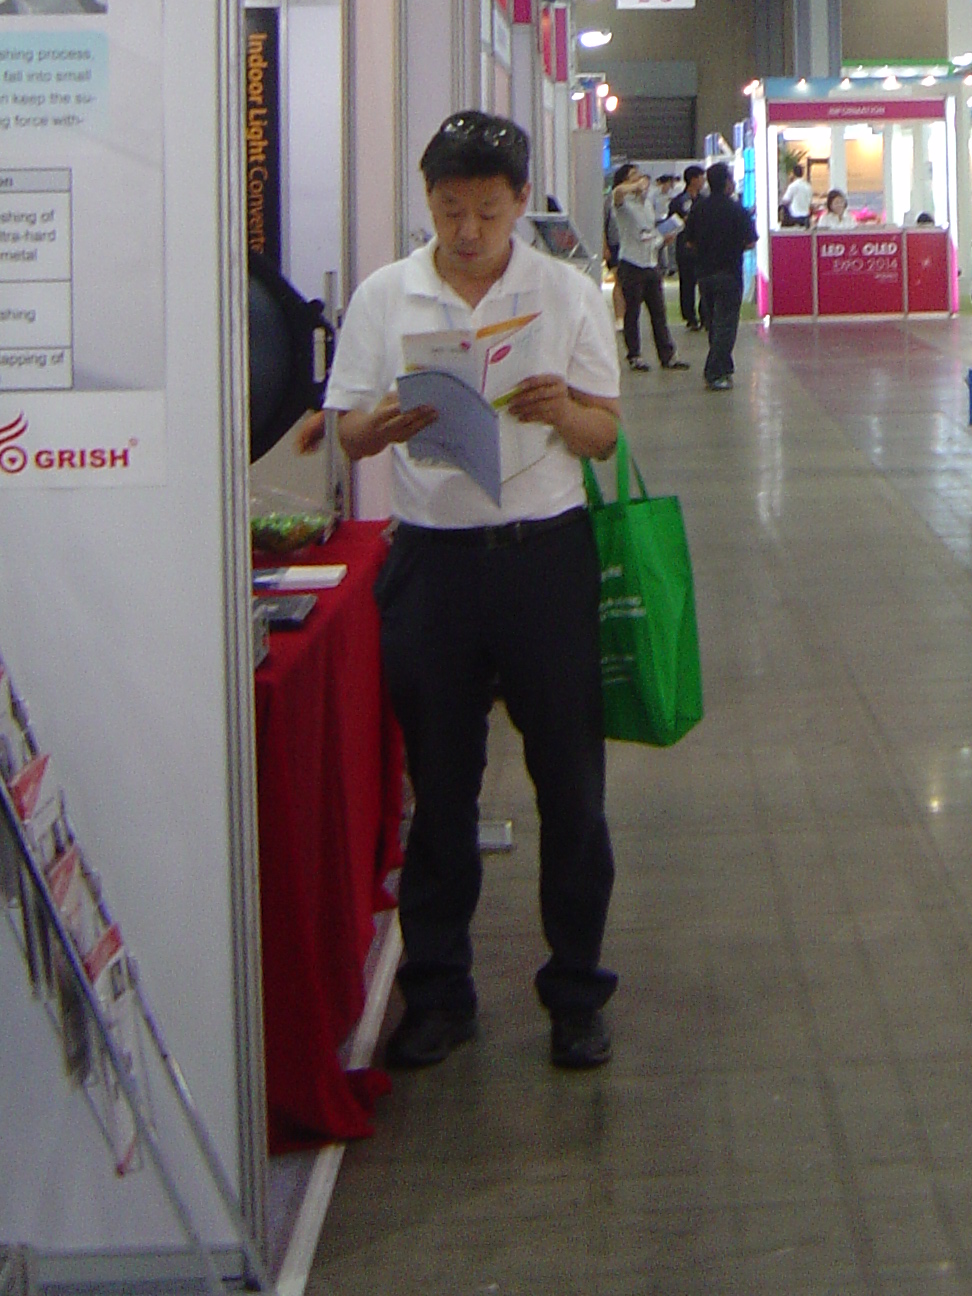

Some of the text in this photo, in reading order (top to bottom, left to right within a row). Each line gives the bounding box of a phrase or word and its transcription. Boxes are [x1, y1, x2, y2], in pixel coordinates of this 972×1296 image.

[248, 32, 268, 104] Indoor
[247, 107, 269, 162] Light
[821, 243, 846, 257] LED
[34, 448, 130, 469] GRISH
